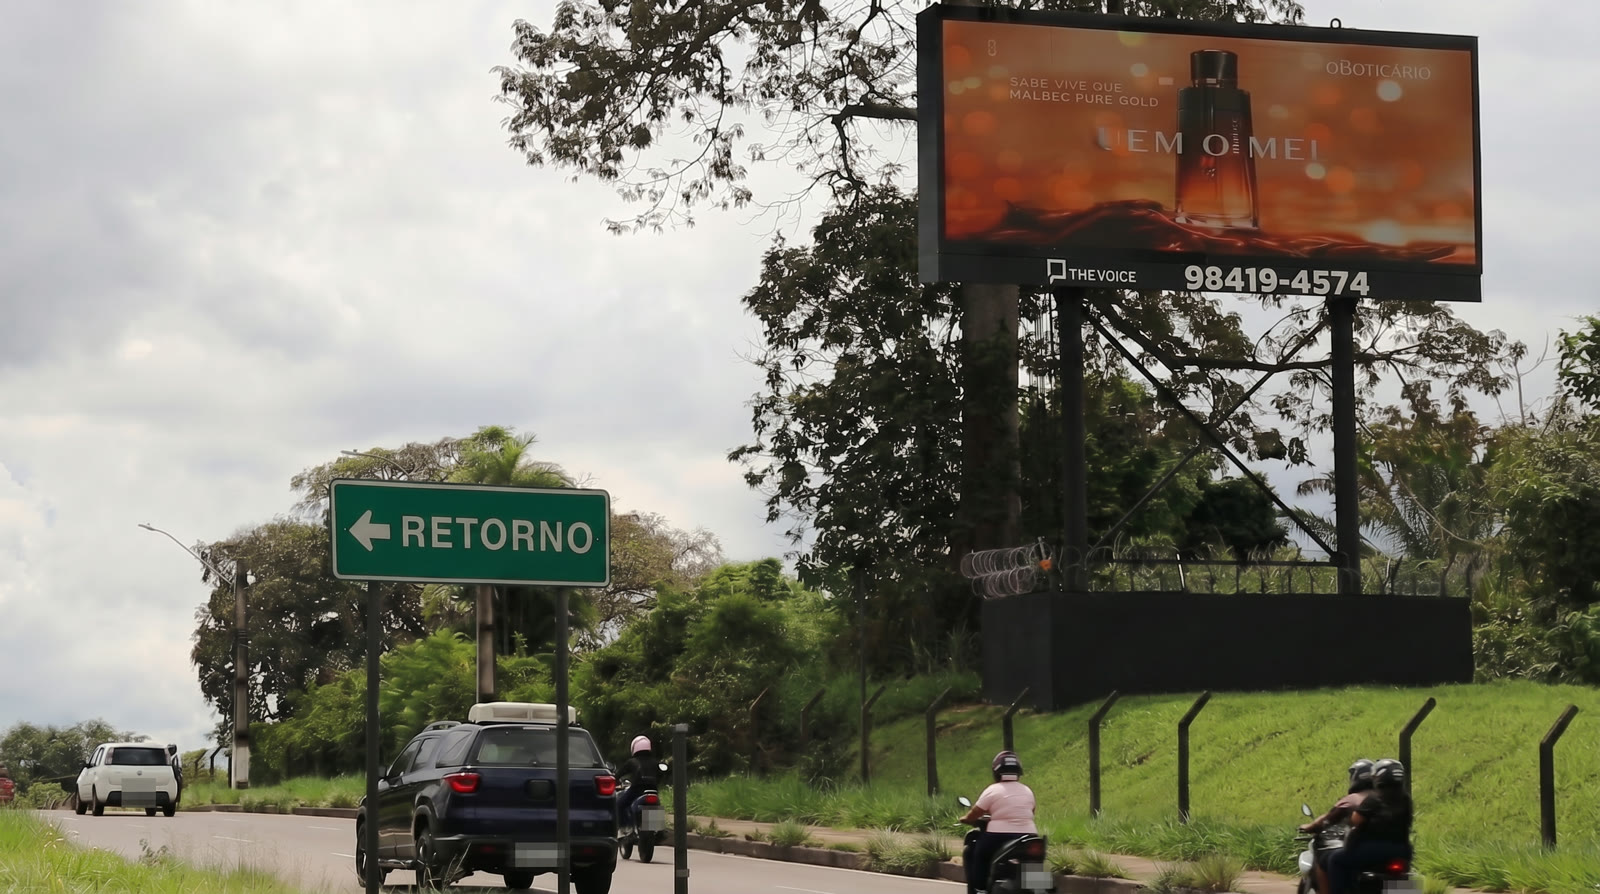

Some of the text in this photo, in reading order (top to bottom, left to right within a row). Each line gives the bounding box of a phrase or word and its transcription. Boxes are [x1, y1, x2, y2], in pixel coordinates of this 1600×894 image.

[1010, 76, 1123, 93] SABE VIVE QUE
[1009, 89, 1159, 107] MALBEC PURE GOLD
[1202, 134, 1230, 157] O
[1184, 264, 1370, 297] 98419-4574
[402, 515, 593, 554] RETORNO
